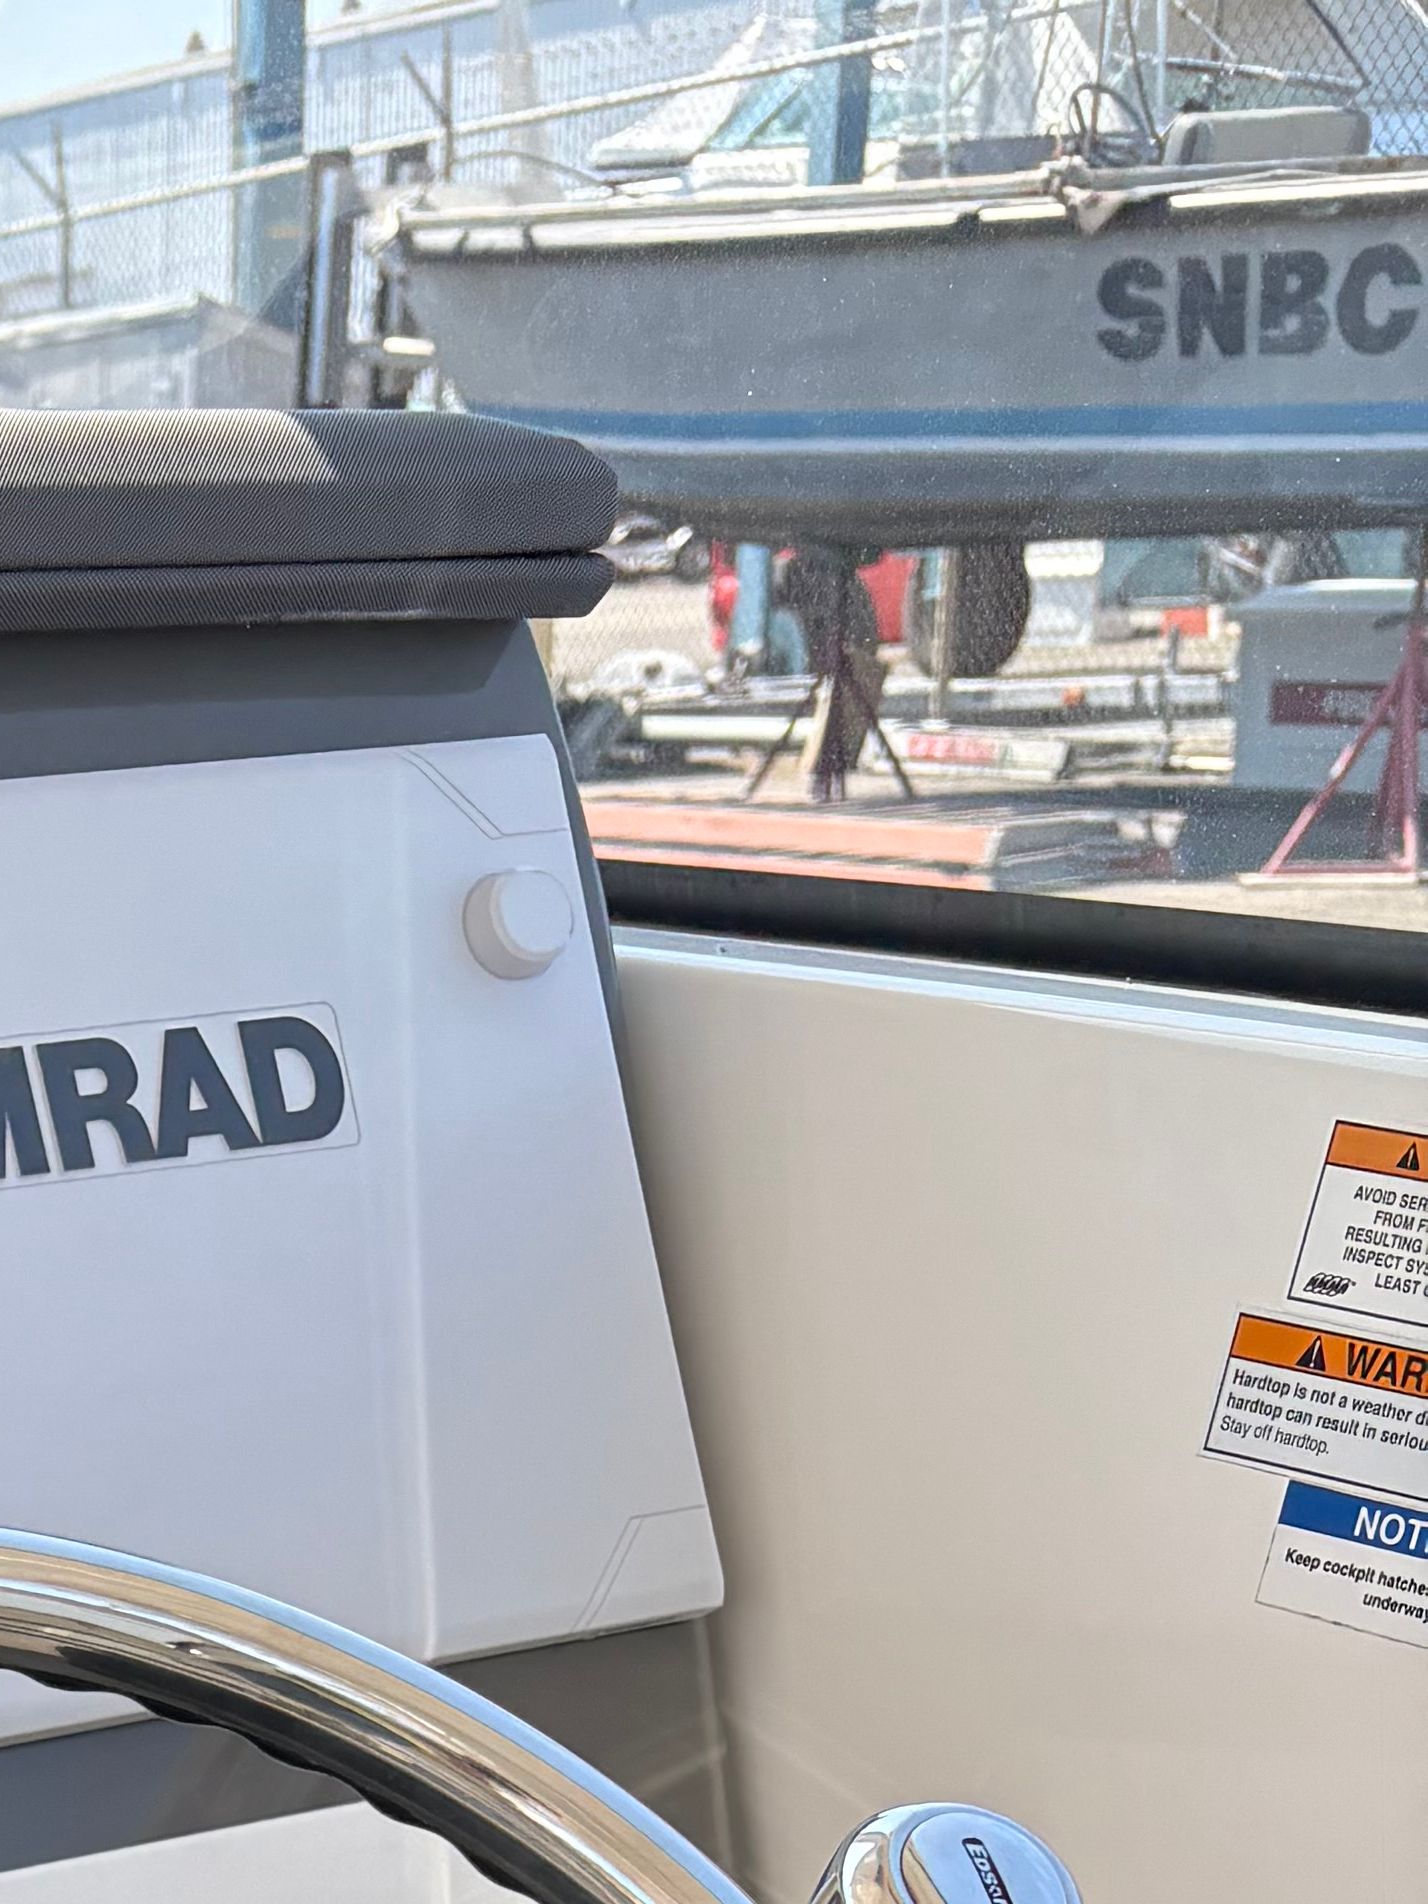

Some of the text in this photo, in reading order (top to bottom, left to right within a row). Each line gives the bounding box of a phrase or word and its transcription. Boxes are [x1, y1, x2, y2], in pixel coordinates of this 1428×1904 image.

[1095, 243, 1423, 363] SNBC
[1353, 1185, 1397, 1206] AVOID
[1373, 1210, 1415, 1230] FROM
[1344, 1226, 1422, 1253] RESULTING
[1342, 1247, 1404, 1270] INSPECT
[1374, 1273, 1421, 1295] LEAST
[1232, 1368, 1291, 1397] Hardtop
[1294, 1383, 1307, 1399] is
[1310, 1389, 1336, 1405] not
[1339, 1395, 1348, 1408] a
[1351, 1398, 1412, 1422] weather
[1226, 1392, 1282, 1420] hardtop
[1285, 1409, 1312, 1427] can
[1315, 1414, 1359, 1436] result
[1362, 1422, 1376, 1439] in
[1220, 1416, 1329, 1456] Stay off hardtop.
[1353, 1506, 1428, 1553] NOT
[1285, 1547, 1320, 1571] Keep
[1323, 1561, 1375, 1584] cockpit
